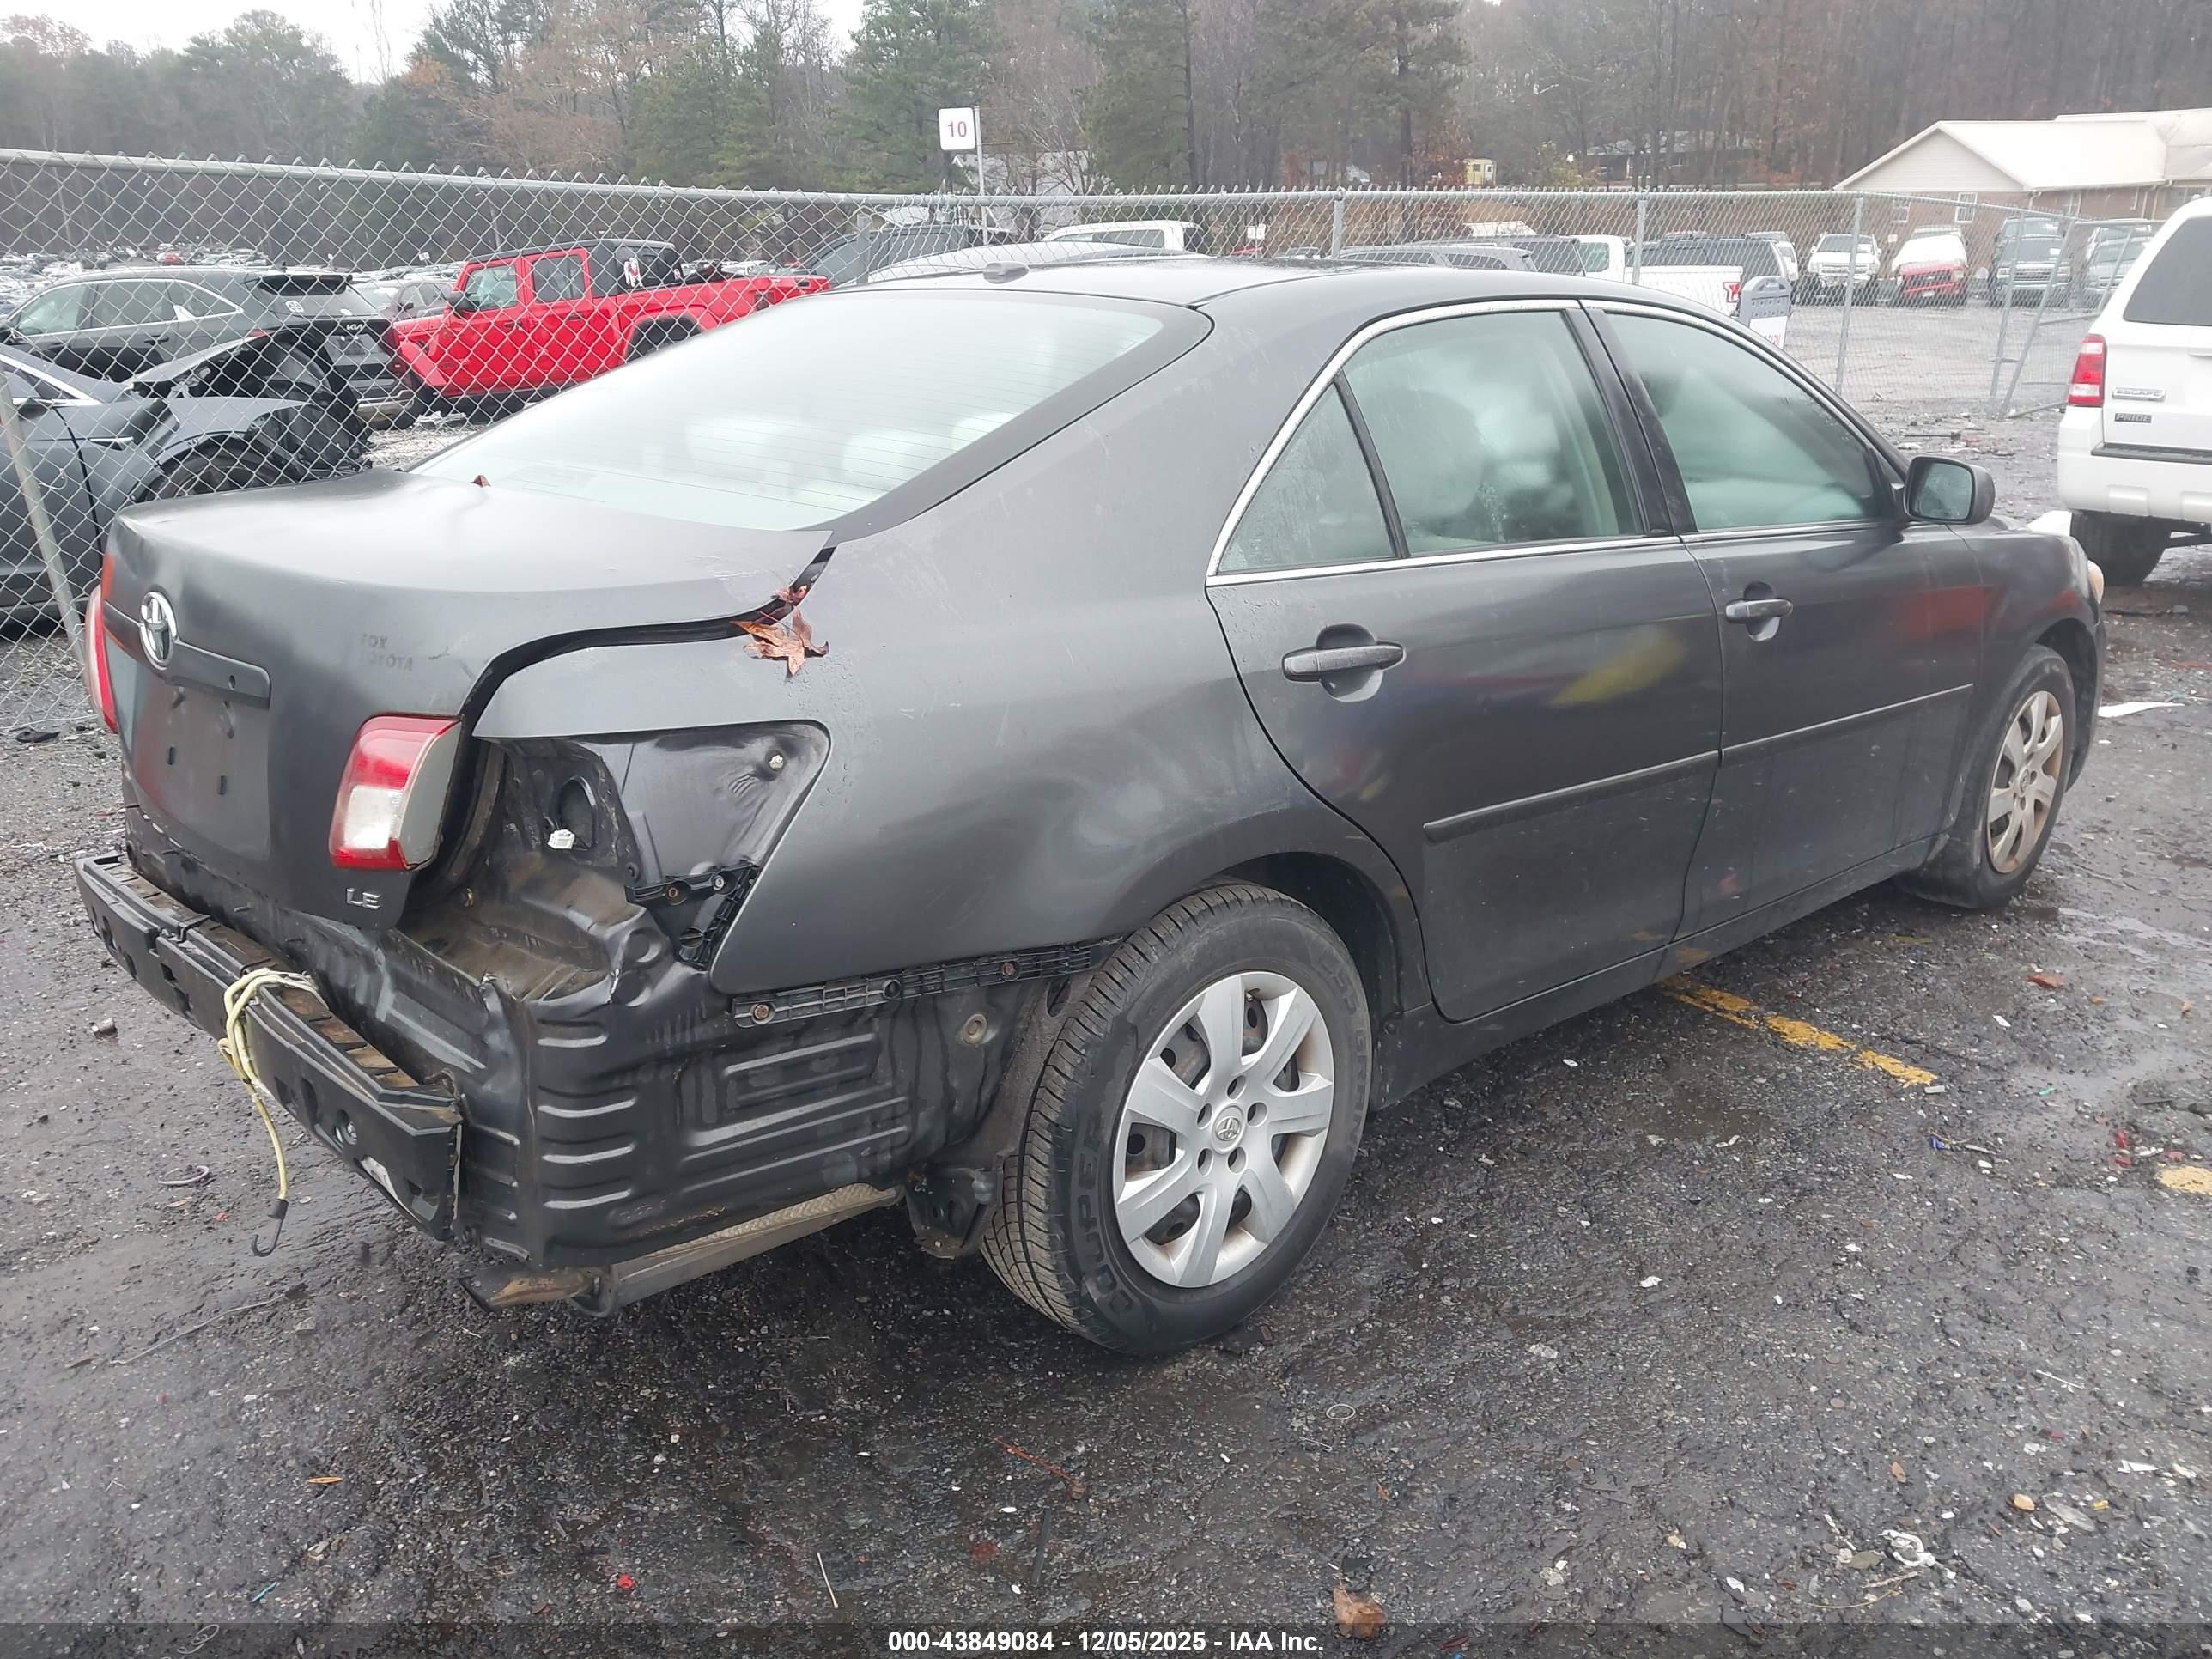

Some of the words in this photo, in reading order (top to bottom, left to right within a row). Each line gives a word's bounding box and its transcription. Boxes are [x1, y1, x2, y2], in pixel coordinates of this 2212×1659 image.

[947, 121, 967, 138] 10
[2116, 413, 2151, 422] PRIDE
[359, 649, 412, 672] TOYOTA
[346, 887, 381, 910] LE
